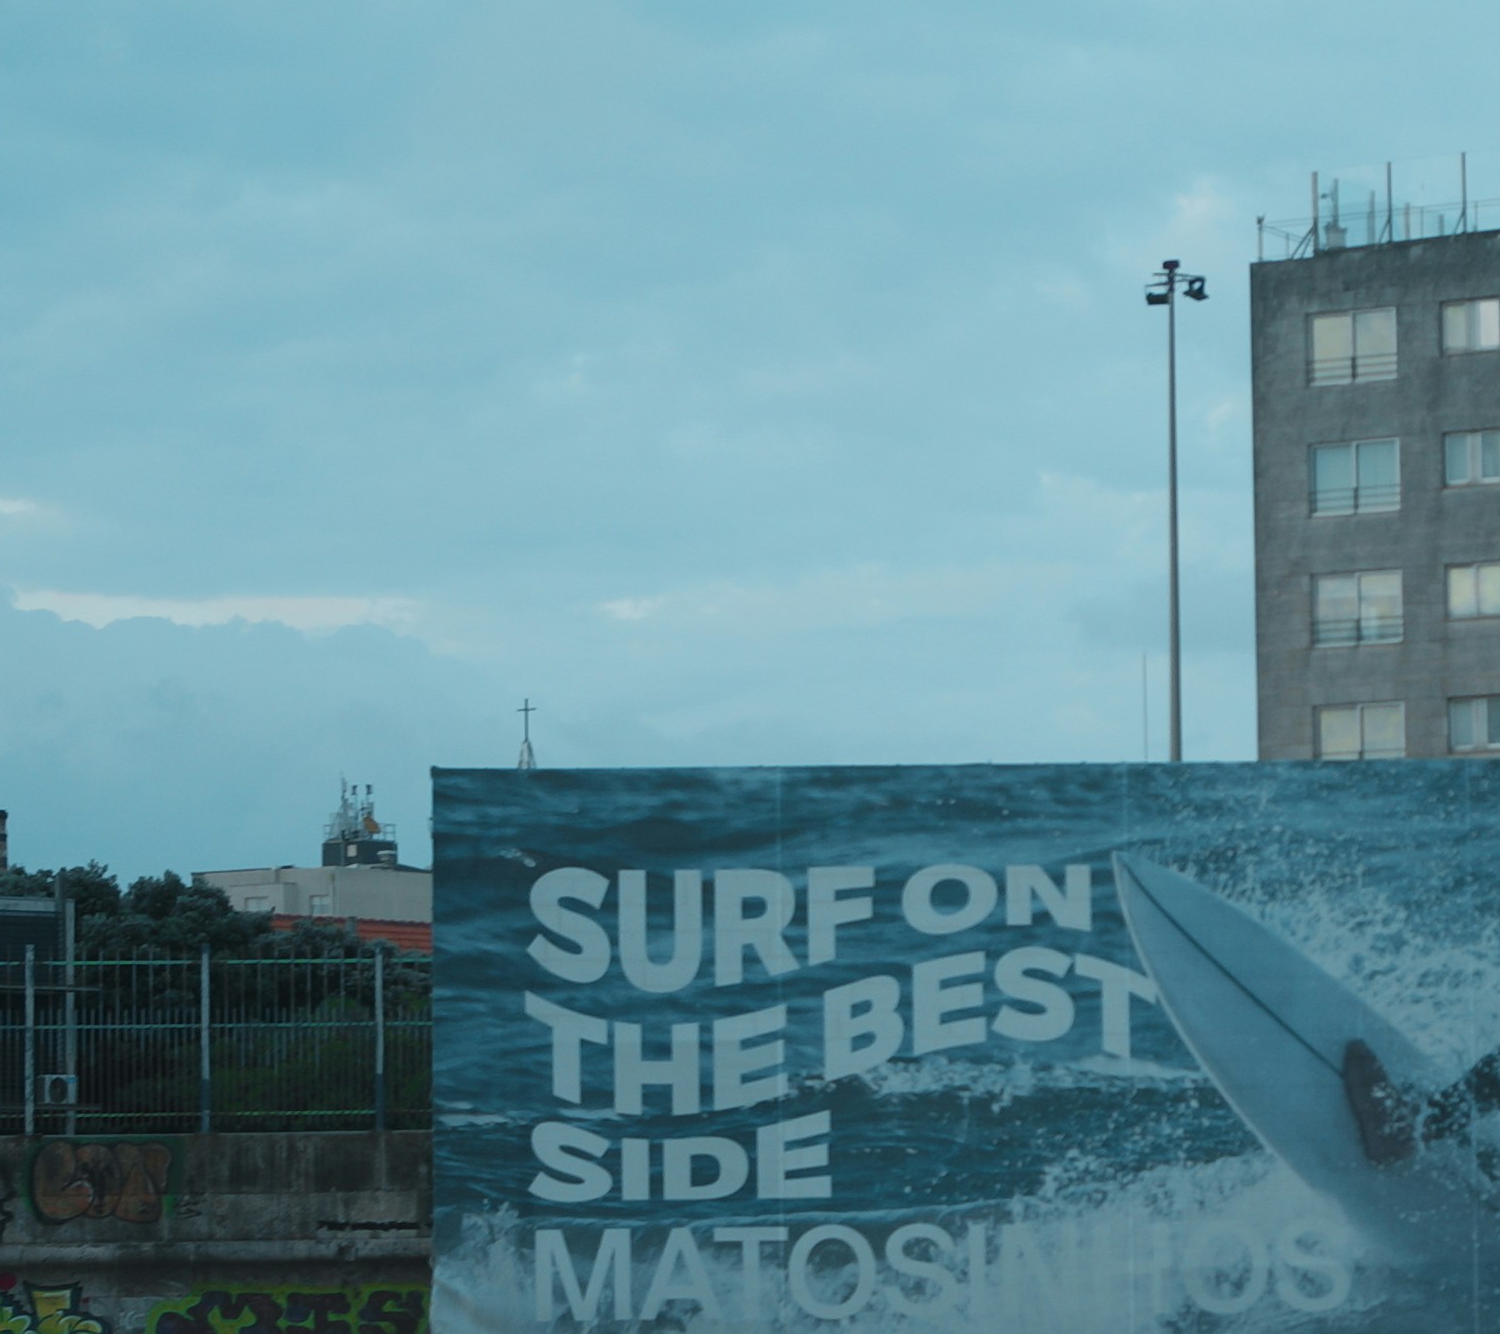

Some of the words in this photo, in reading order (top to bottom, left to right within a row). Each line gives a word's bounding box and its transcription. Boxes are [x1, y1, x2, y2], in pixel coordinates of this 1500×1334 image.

[526, 866, 875, 993] SURF
[901, 864, 1092, 934] ON
[525, 990, 788, 1116] THE
[823, 946, 1159, 1082] BEST
[527, 1110, 833, 1203] SIDE
[534, 1222, 1351, 1322] MATOSINHOS
